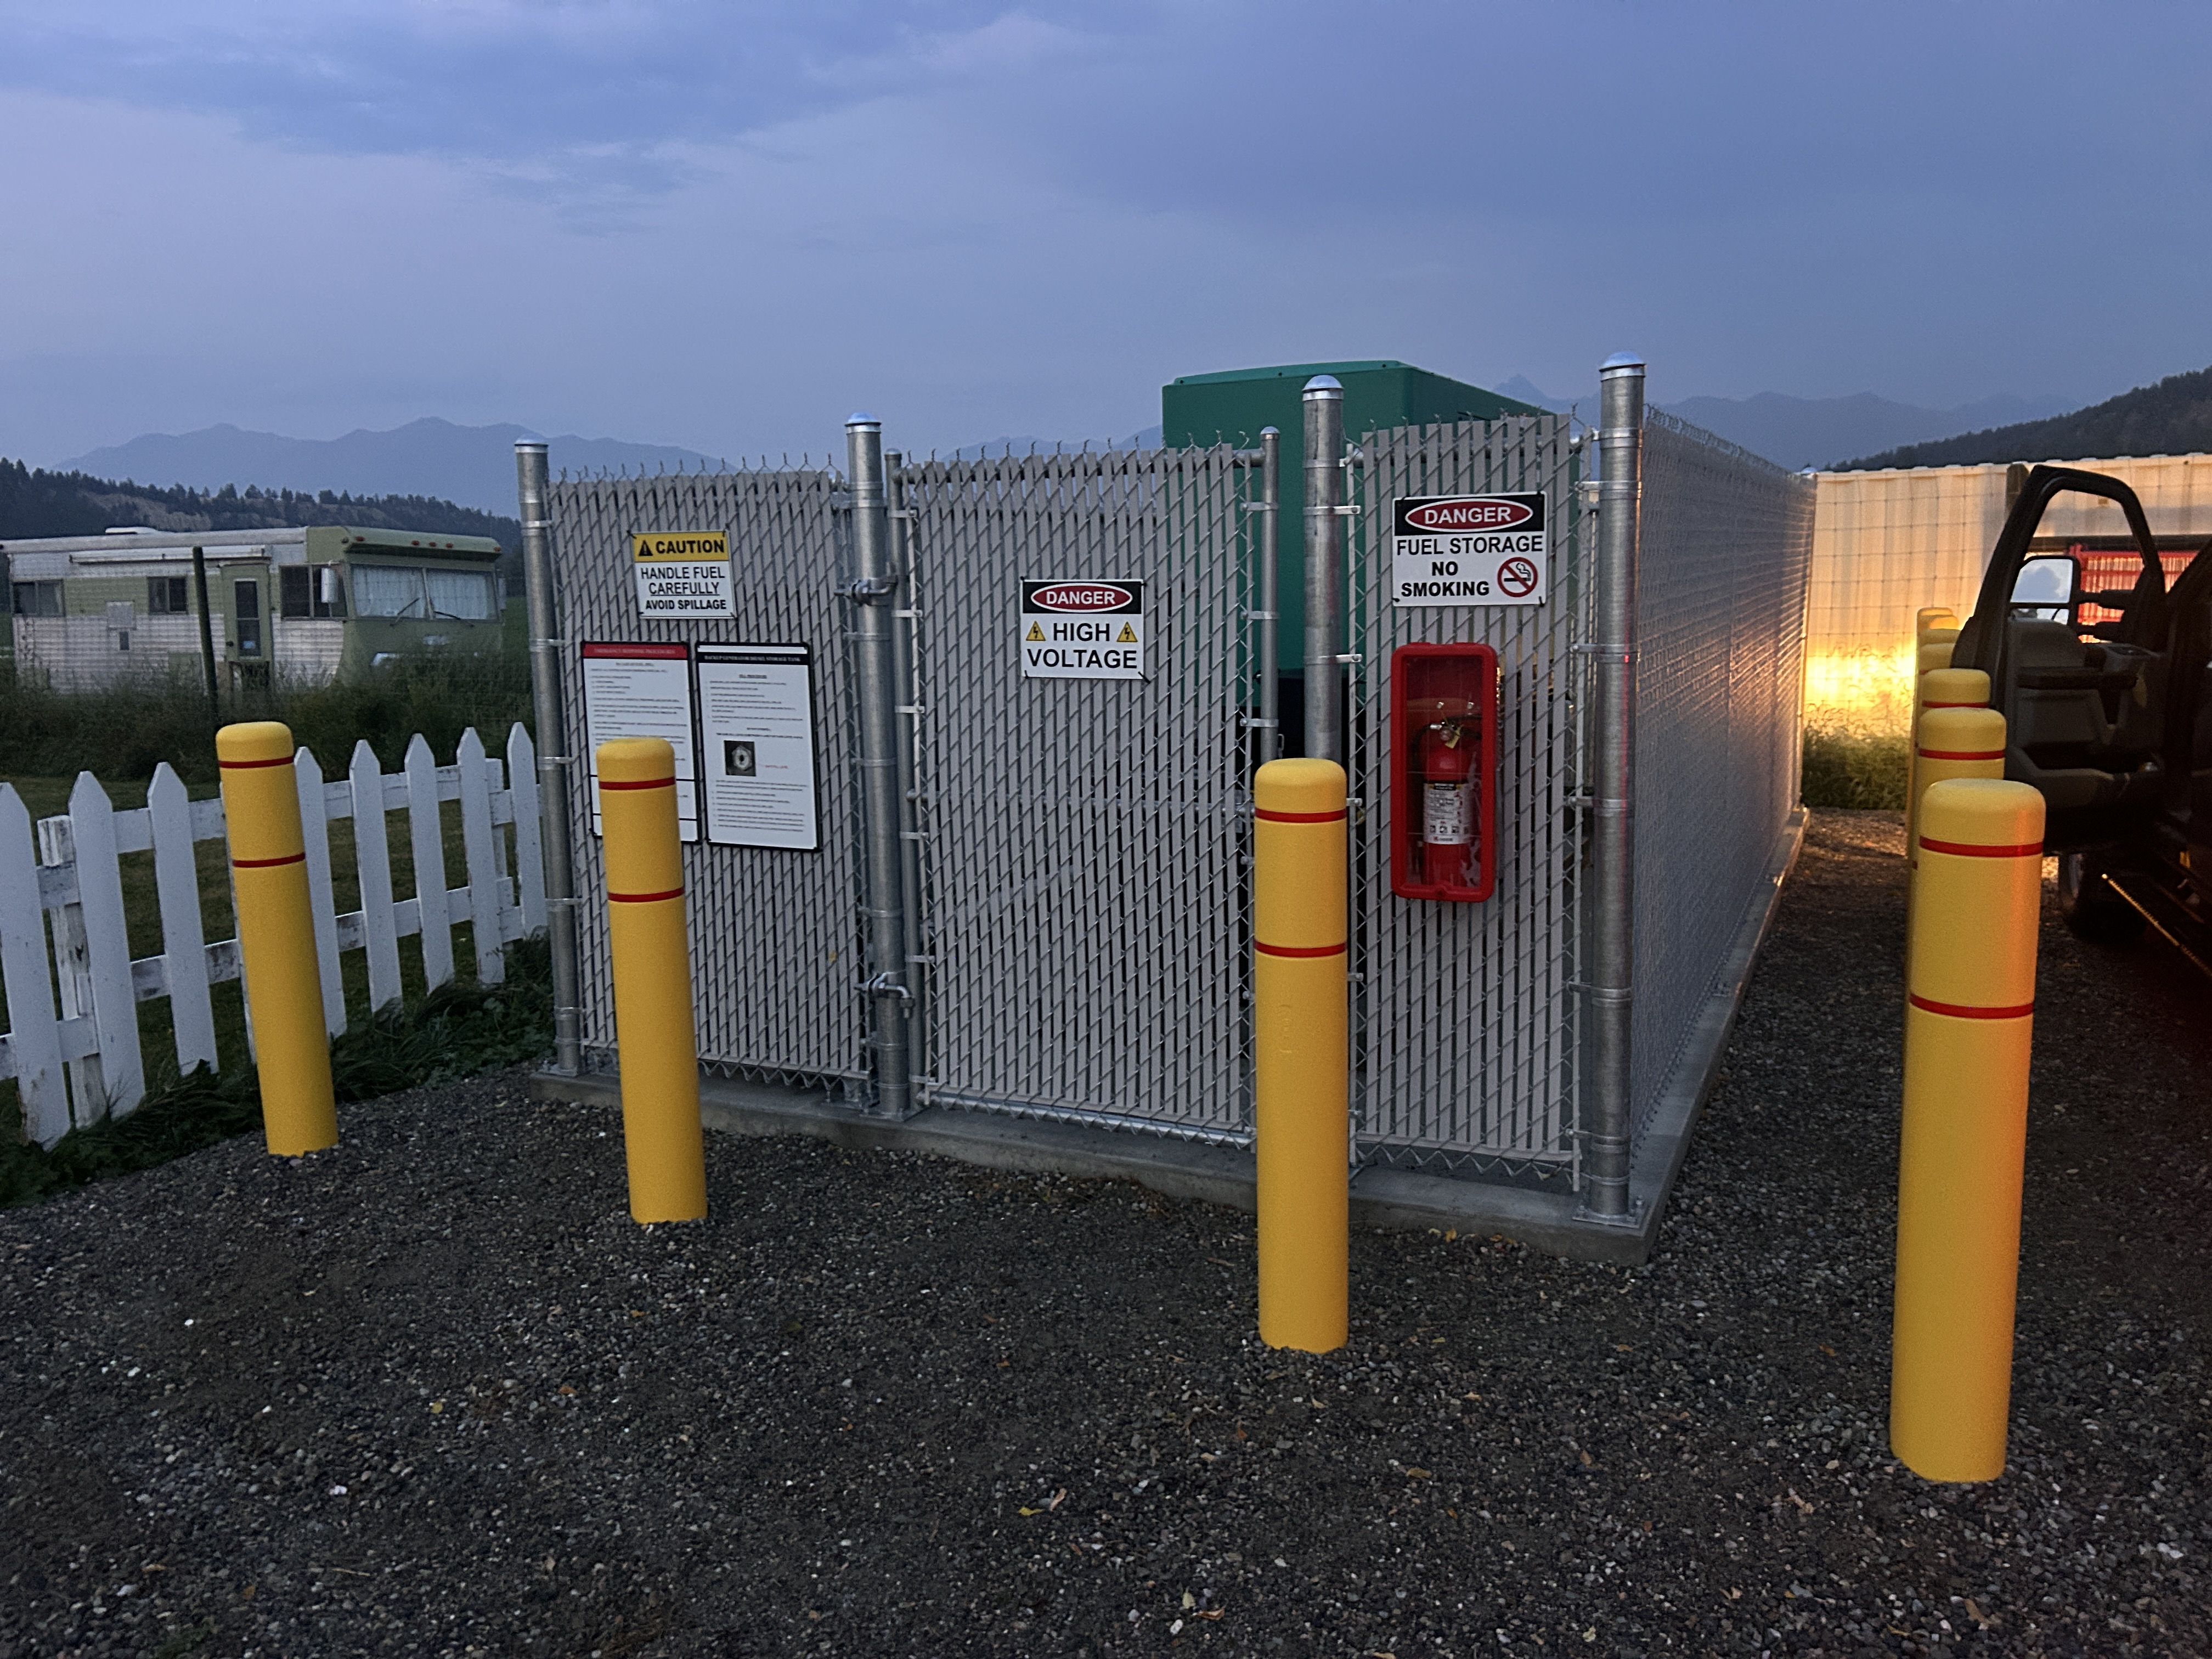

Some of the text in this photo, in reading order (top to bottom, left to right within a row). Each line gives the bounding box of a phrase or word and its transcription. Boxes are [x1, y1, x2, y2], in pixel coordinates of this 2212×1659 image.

[1425, 507, 1511, 524] DANGER
[656, 540, 724, 554] CAUTION
[1397, 535, 1543, 556] FUEL STORAGE
[641, 566, 725, 579] HANDLE FUEL
[1432, 561, 1458, 576] NO
[648, 582, 719, 594] CAREFULLY
[1401, 581, 1489, 597] SMOKING
[645, 600, 727, 610] AVOID SPILLAGE
[1046, 591, 1115, 605] DANGER
[1053, 623, 1110, 641] HIGH
[1027, 648, 1137, 669] VOLTAGE
